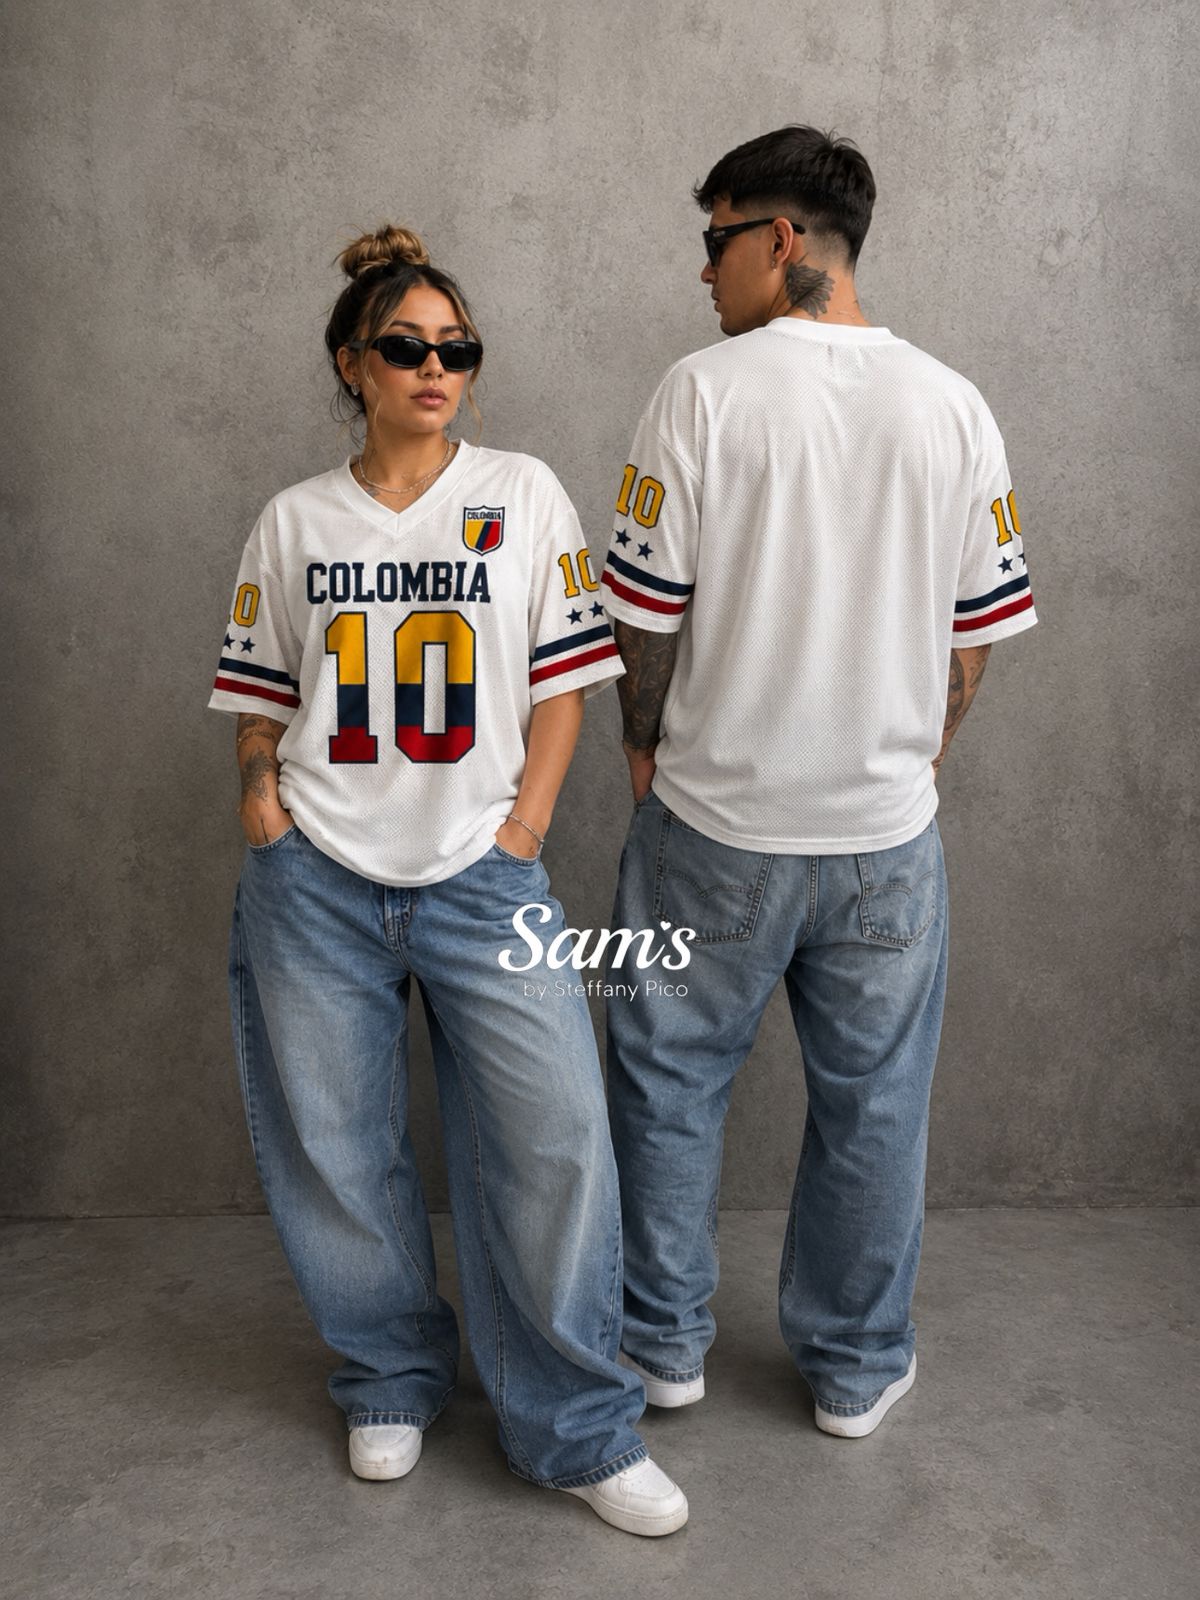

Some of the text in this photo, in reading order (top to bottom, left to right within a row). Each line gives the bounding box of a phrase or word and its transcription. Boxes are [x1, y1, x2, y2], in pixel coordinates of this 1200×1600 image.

[615, 463, 666, 529] 10
[228, 582, 261, 628] 0
[306, 561, 491, 604] COLOMBIA
[325, 610, 476, 764] 10
